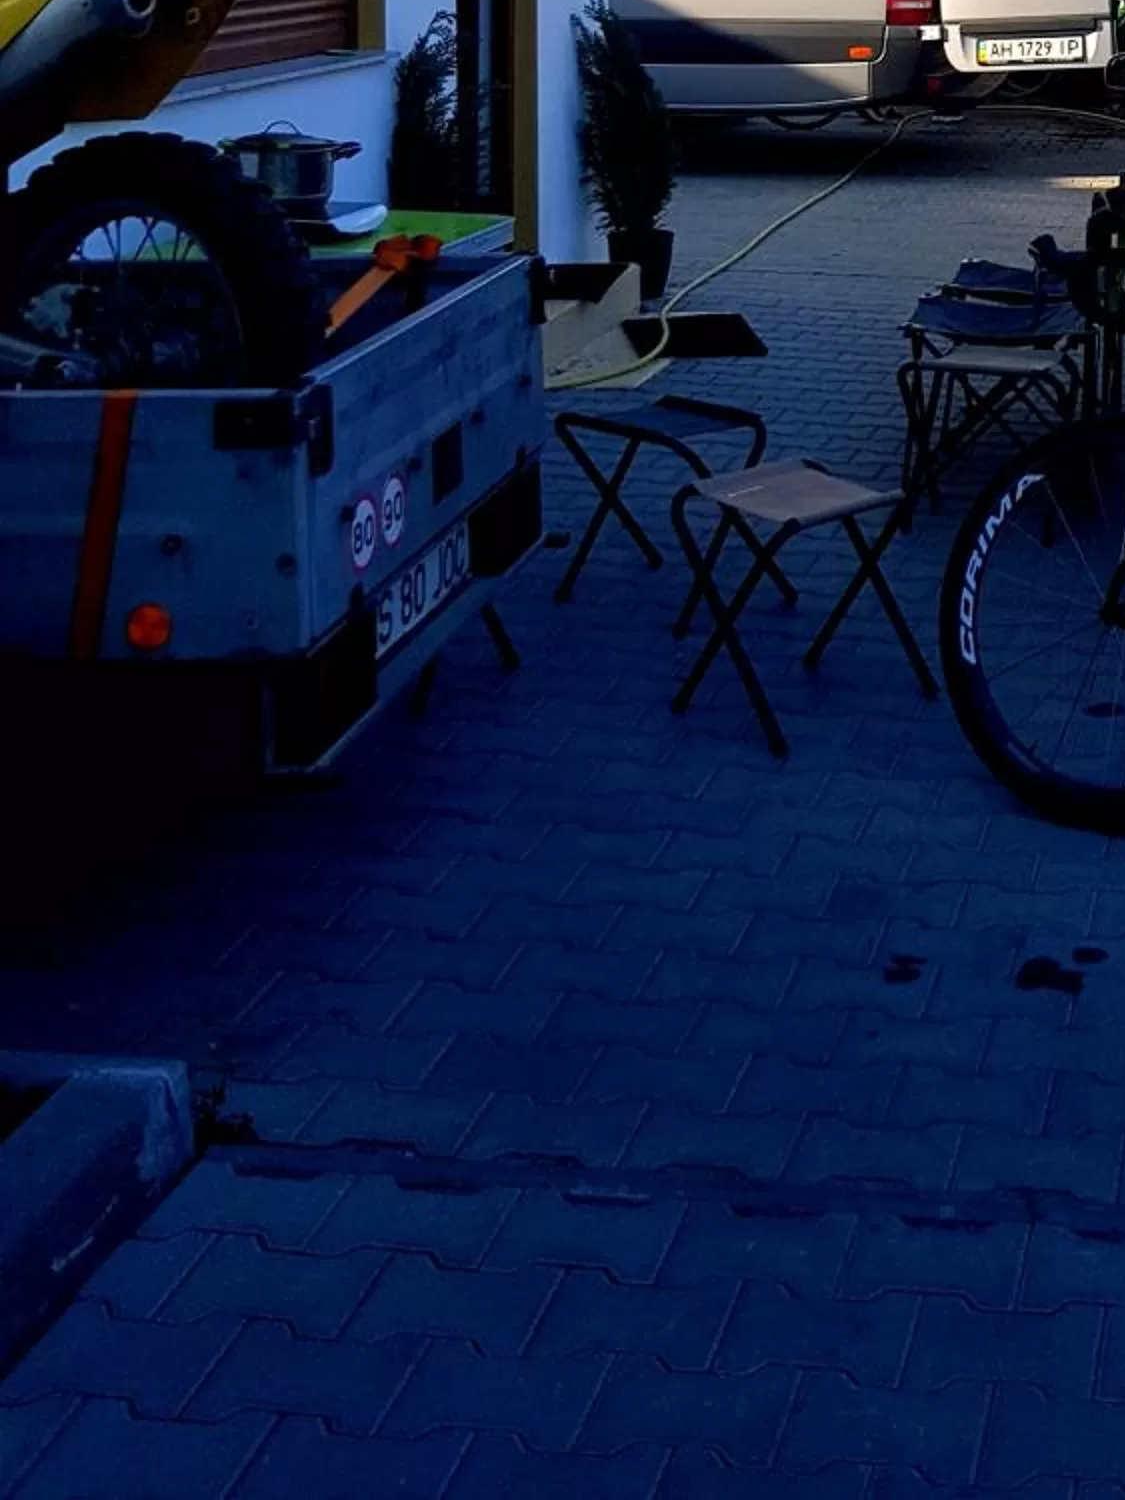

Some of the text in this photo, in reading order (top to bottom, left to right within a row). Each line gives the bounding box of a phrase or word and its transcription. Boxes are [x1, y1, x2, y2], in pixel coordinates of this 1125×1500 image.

[990, 39, 1080, 58] AH 1729 IP
[383, 490, 404, 532] 90
[352, 514, 376, 555] 80
[957, 471, 1047, 667] CORIMA
[400, 561, 426, 626] 80
